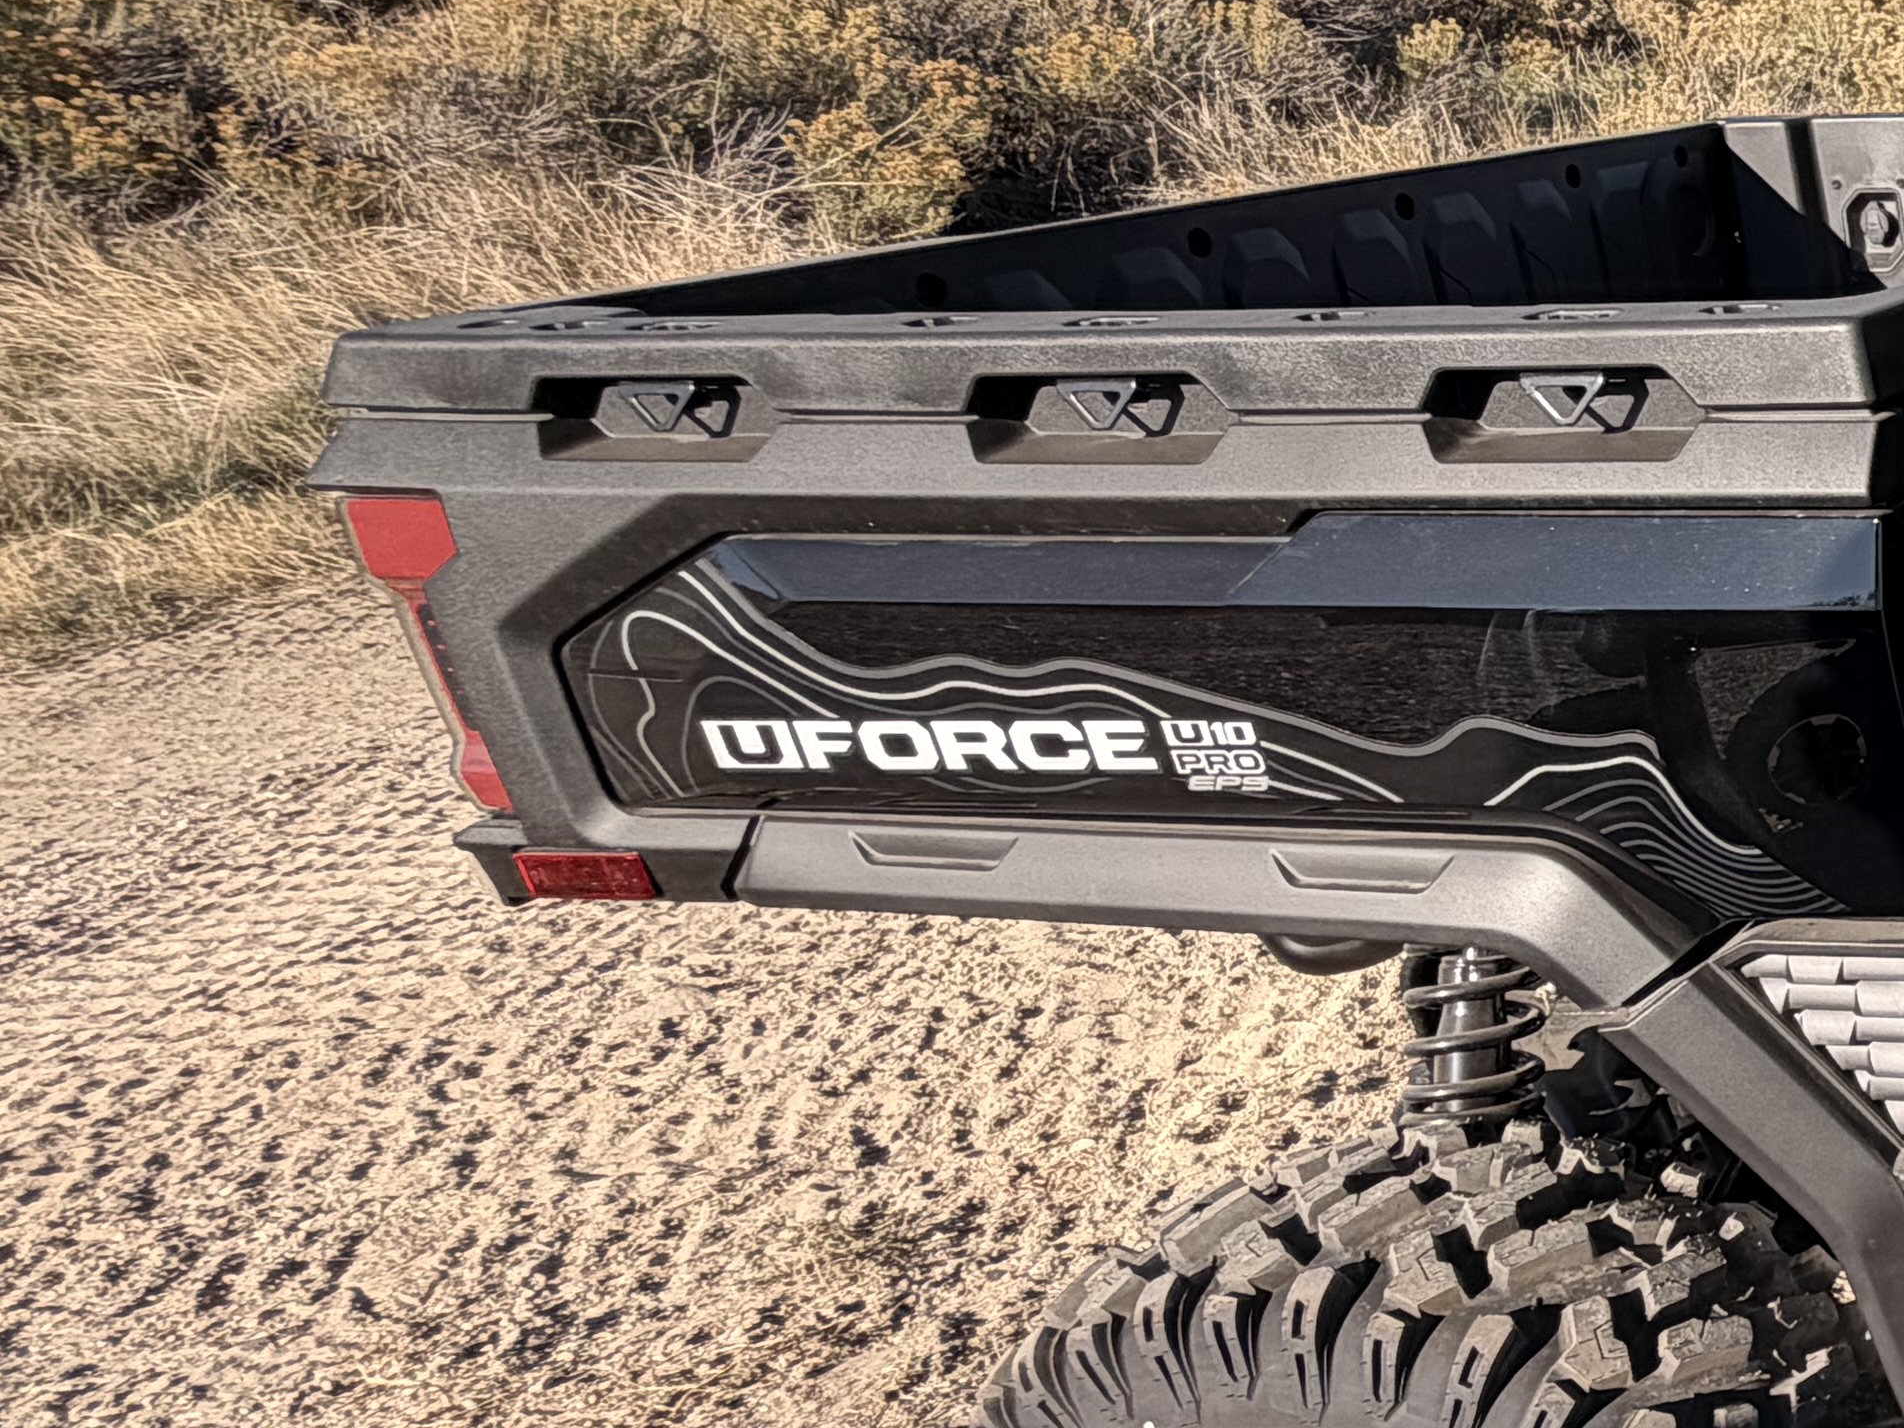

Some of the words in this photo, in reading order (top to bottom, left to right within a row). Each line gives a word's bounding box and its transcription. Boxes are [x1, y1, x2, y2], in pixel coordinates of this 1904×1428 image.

[700, 720, 1159, 771] UFORCE
[1160, 720, 1257, 746] U10
[1170, 749, 1267, 774] PRO
[1187, 775, 1270, 791] EPS
